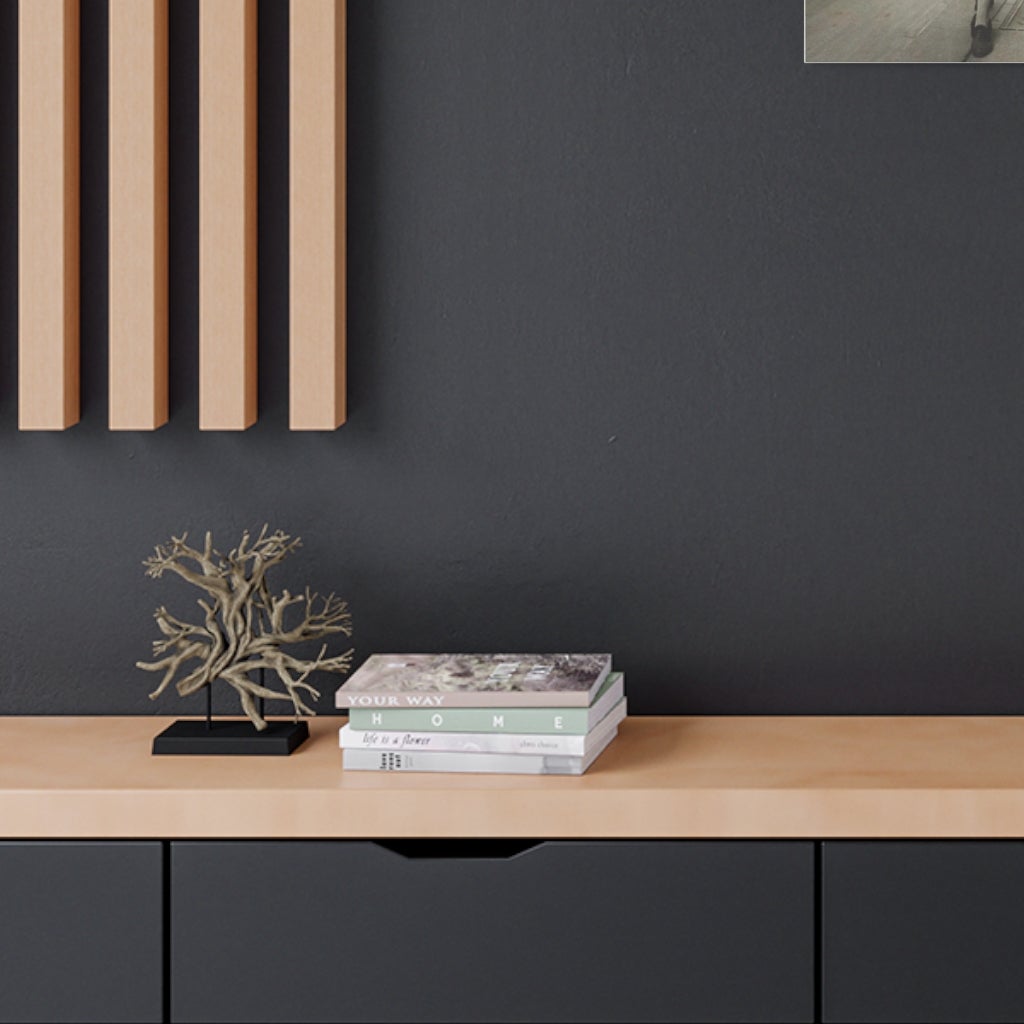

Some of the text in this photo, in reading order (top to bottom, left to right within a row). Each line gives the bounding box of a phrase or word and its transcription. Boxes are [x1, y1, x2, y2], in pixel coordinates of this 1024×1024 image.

[348, 695, 445, 706] YOUR WAY
[372, 713, 562, 728] HOME
[363, 732, 378, 746] life
[401, 734, 431, 747] flower
